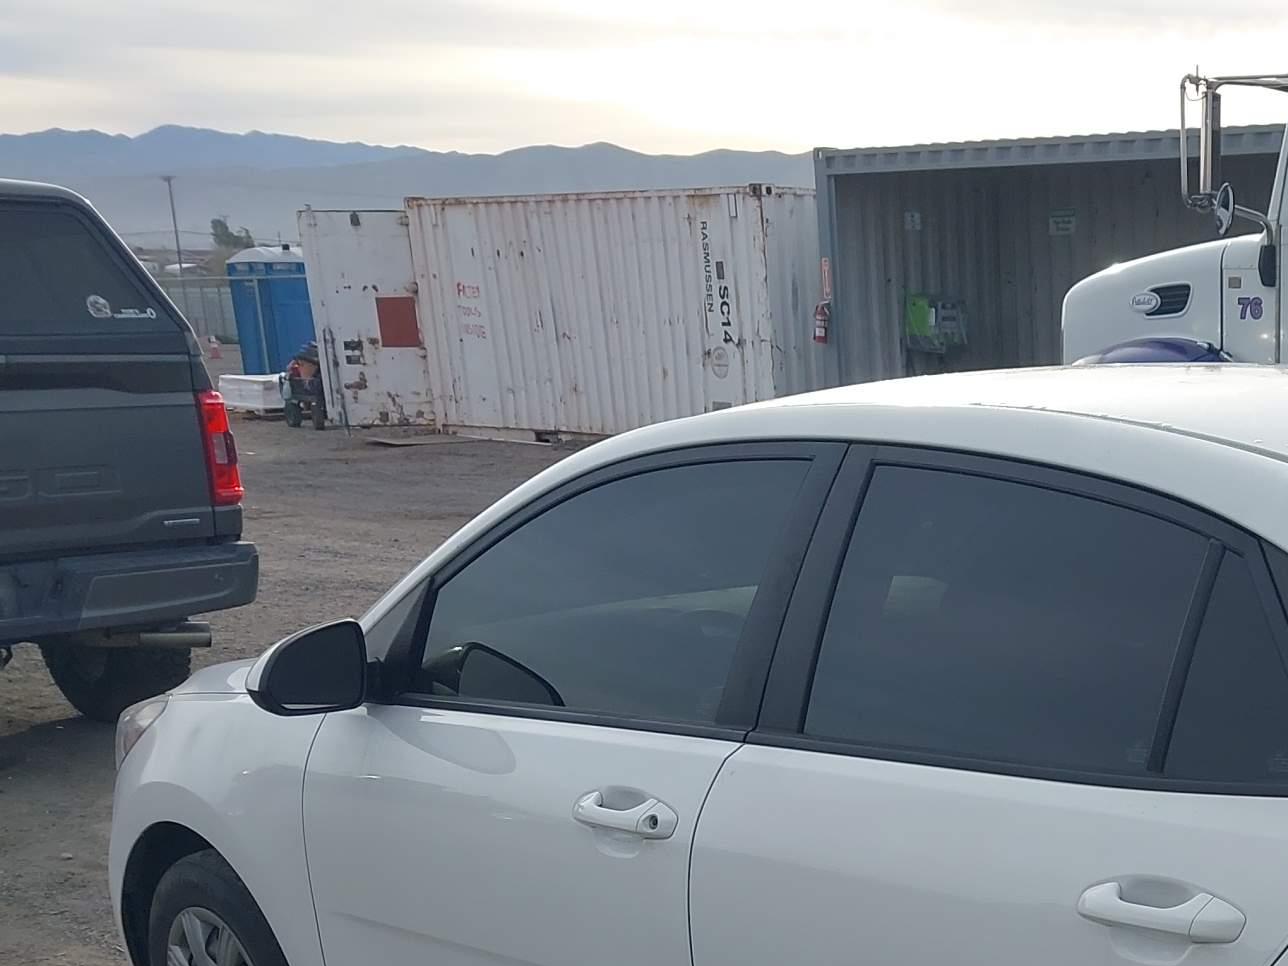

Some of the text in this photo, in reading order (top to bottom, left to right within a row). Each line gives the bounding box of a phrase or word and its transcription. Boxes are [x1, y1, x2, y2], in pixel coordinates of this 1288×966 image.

[700, 221, 714, 313] RASMUSSEN
[719, 285, 737, 346] SC14
[1237, 297, 1263, 320] 76
